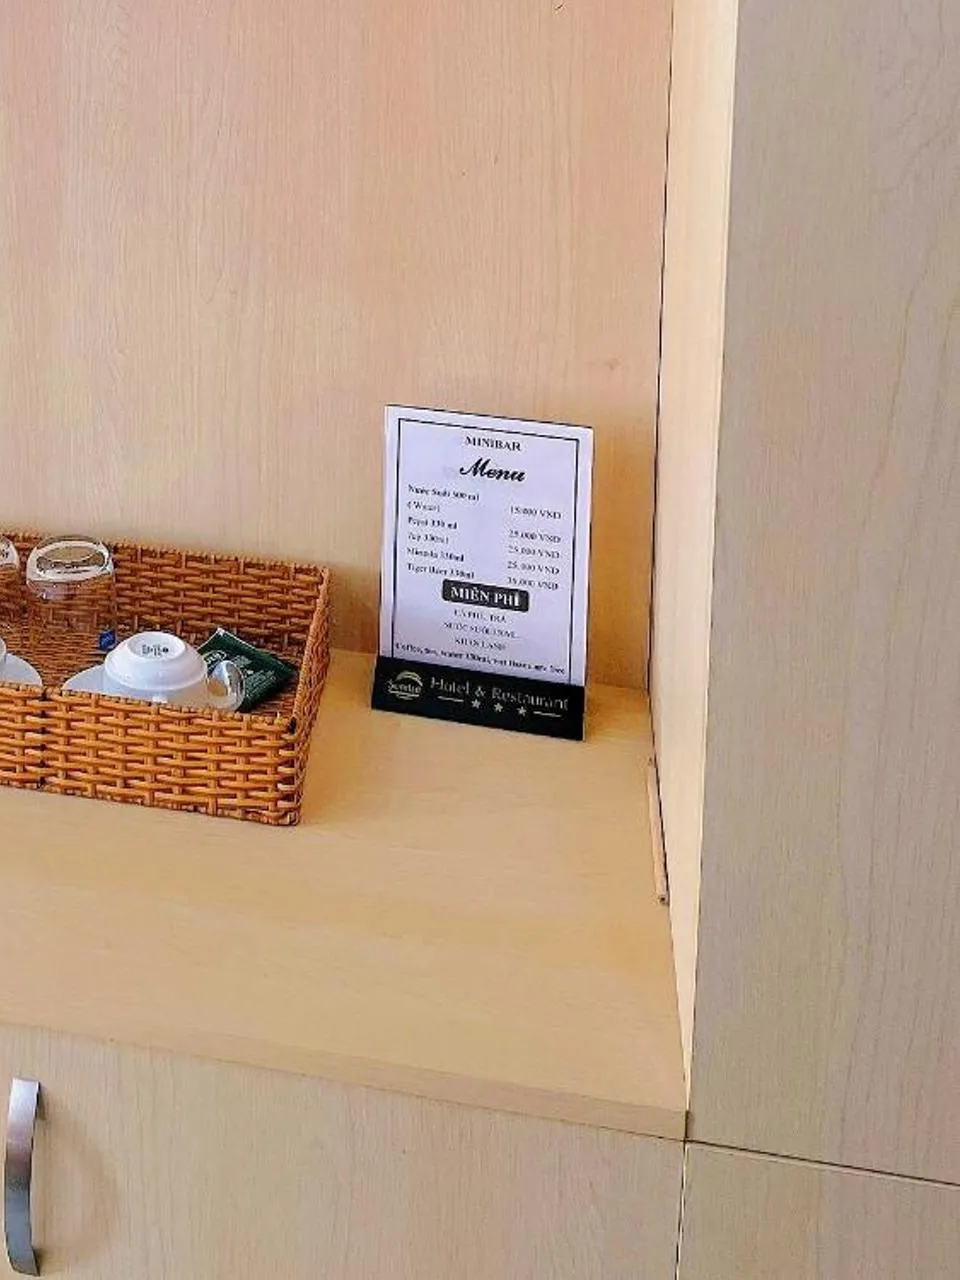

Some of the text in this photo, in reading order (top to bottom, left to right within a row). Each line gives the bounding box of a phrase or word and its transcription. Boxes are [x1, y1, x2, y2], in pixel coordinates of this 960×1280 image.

[464, 436, 521, 452] MINIBAR
[459, 457, 526, 483] Menu
[430, 677, 569, 711] Hotel & Restaurant
